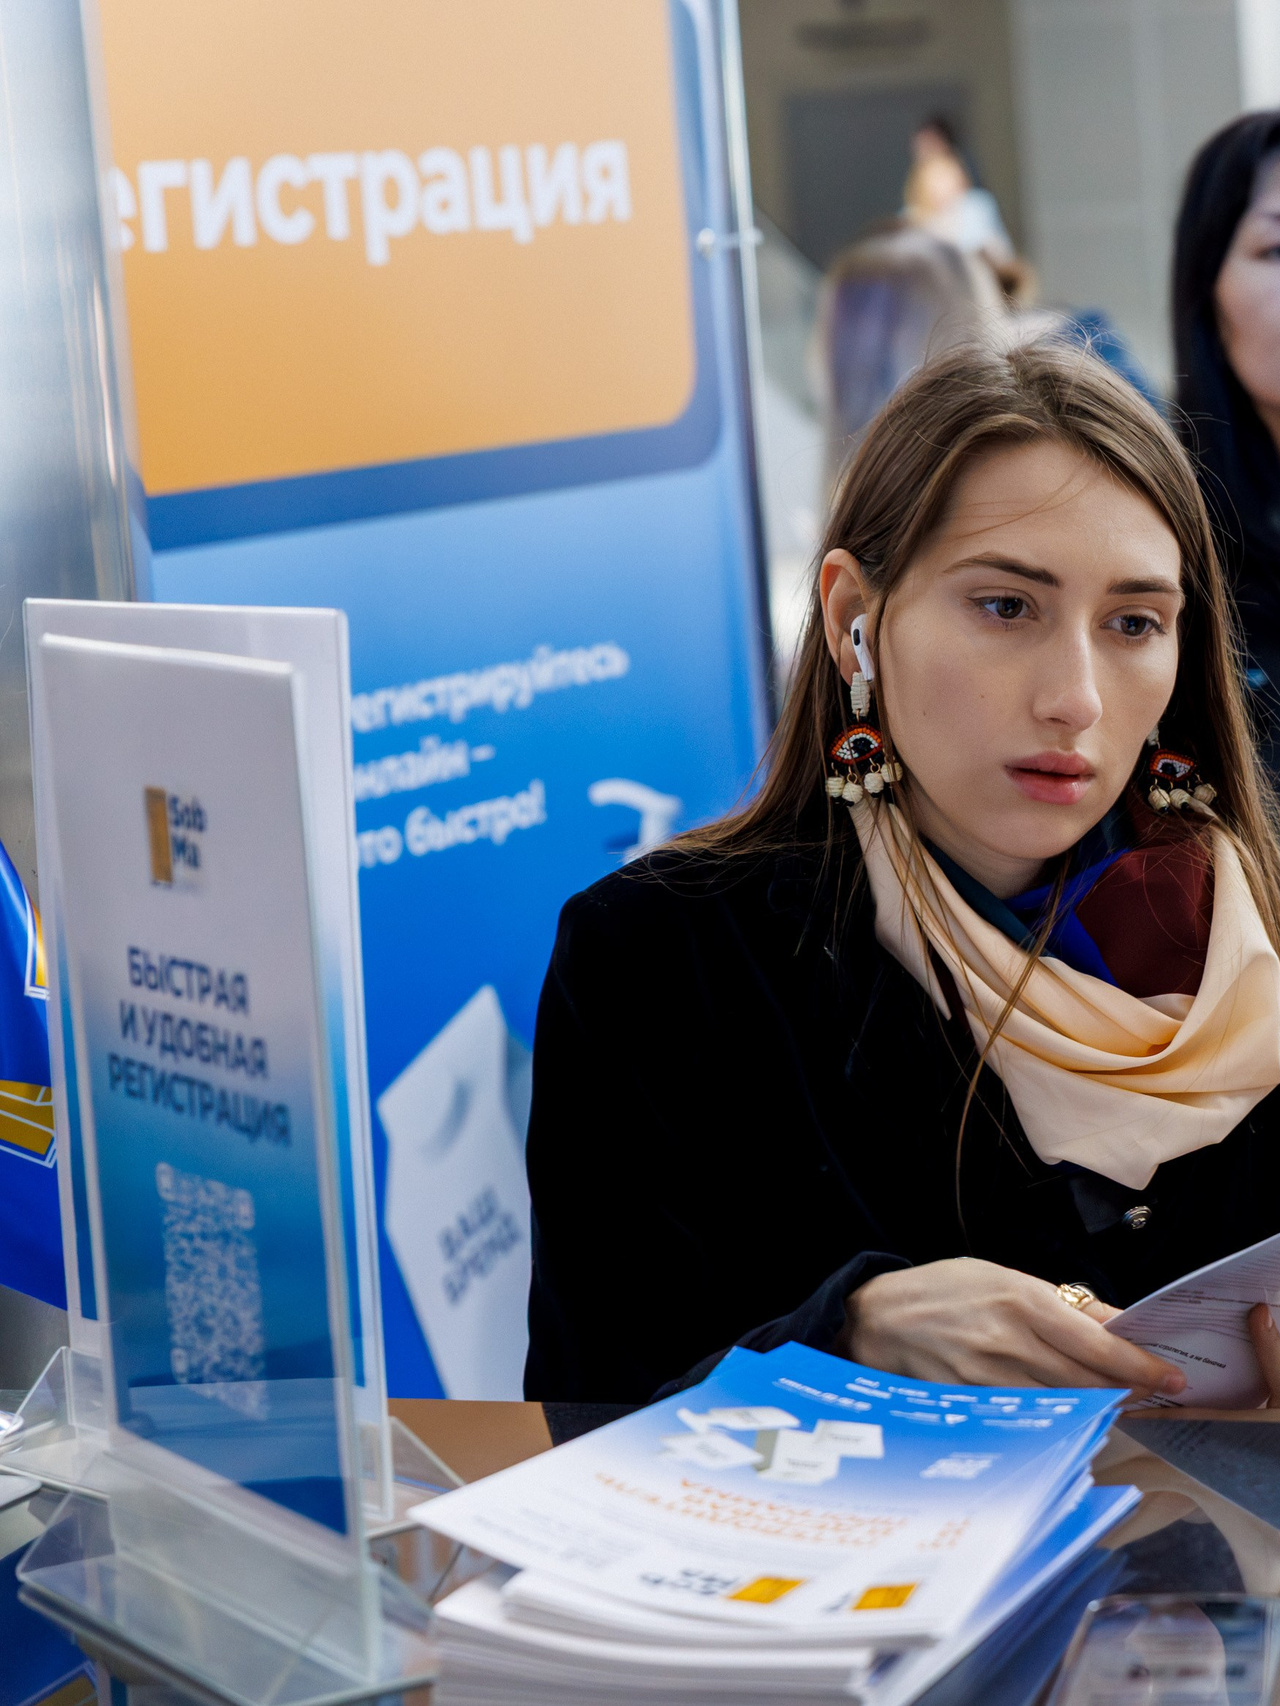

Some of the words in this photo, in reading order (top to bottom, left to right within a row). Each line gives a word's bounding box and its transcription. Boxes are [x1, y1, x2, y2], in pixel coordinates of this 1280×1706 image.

[403, 777, 547, 857] быстро!
[127, 945, 250, 1017] БЫСТРАЯ
[119, 999, 139, 1043] И
[141, 1005, 269, 1080] УДОБНАЯ
[107, 1052, 292, 1147] РЕГИСТРАЦИЯ
